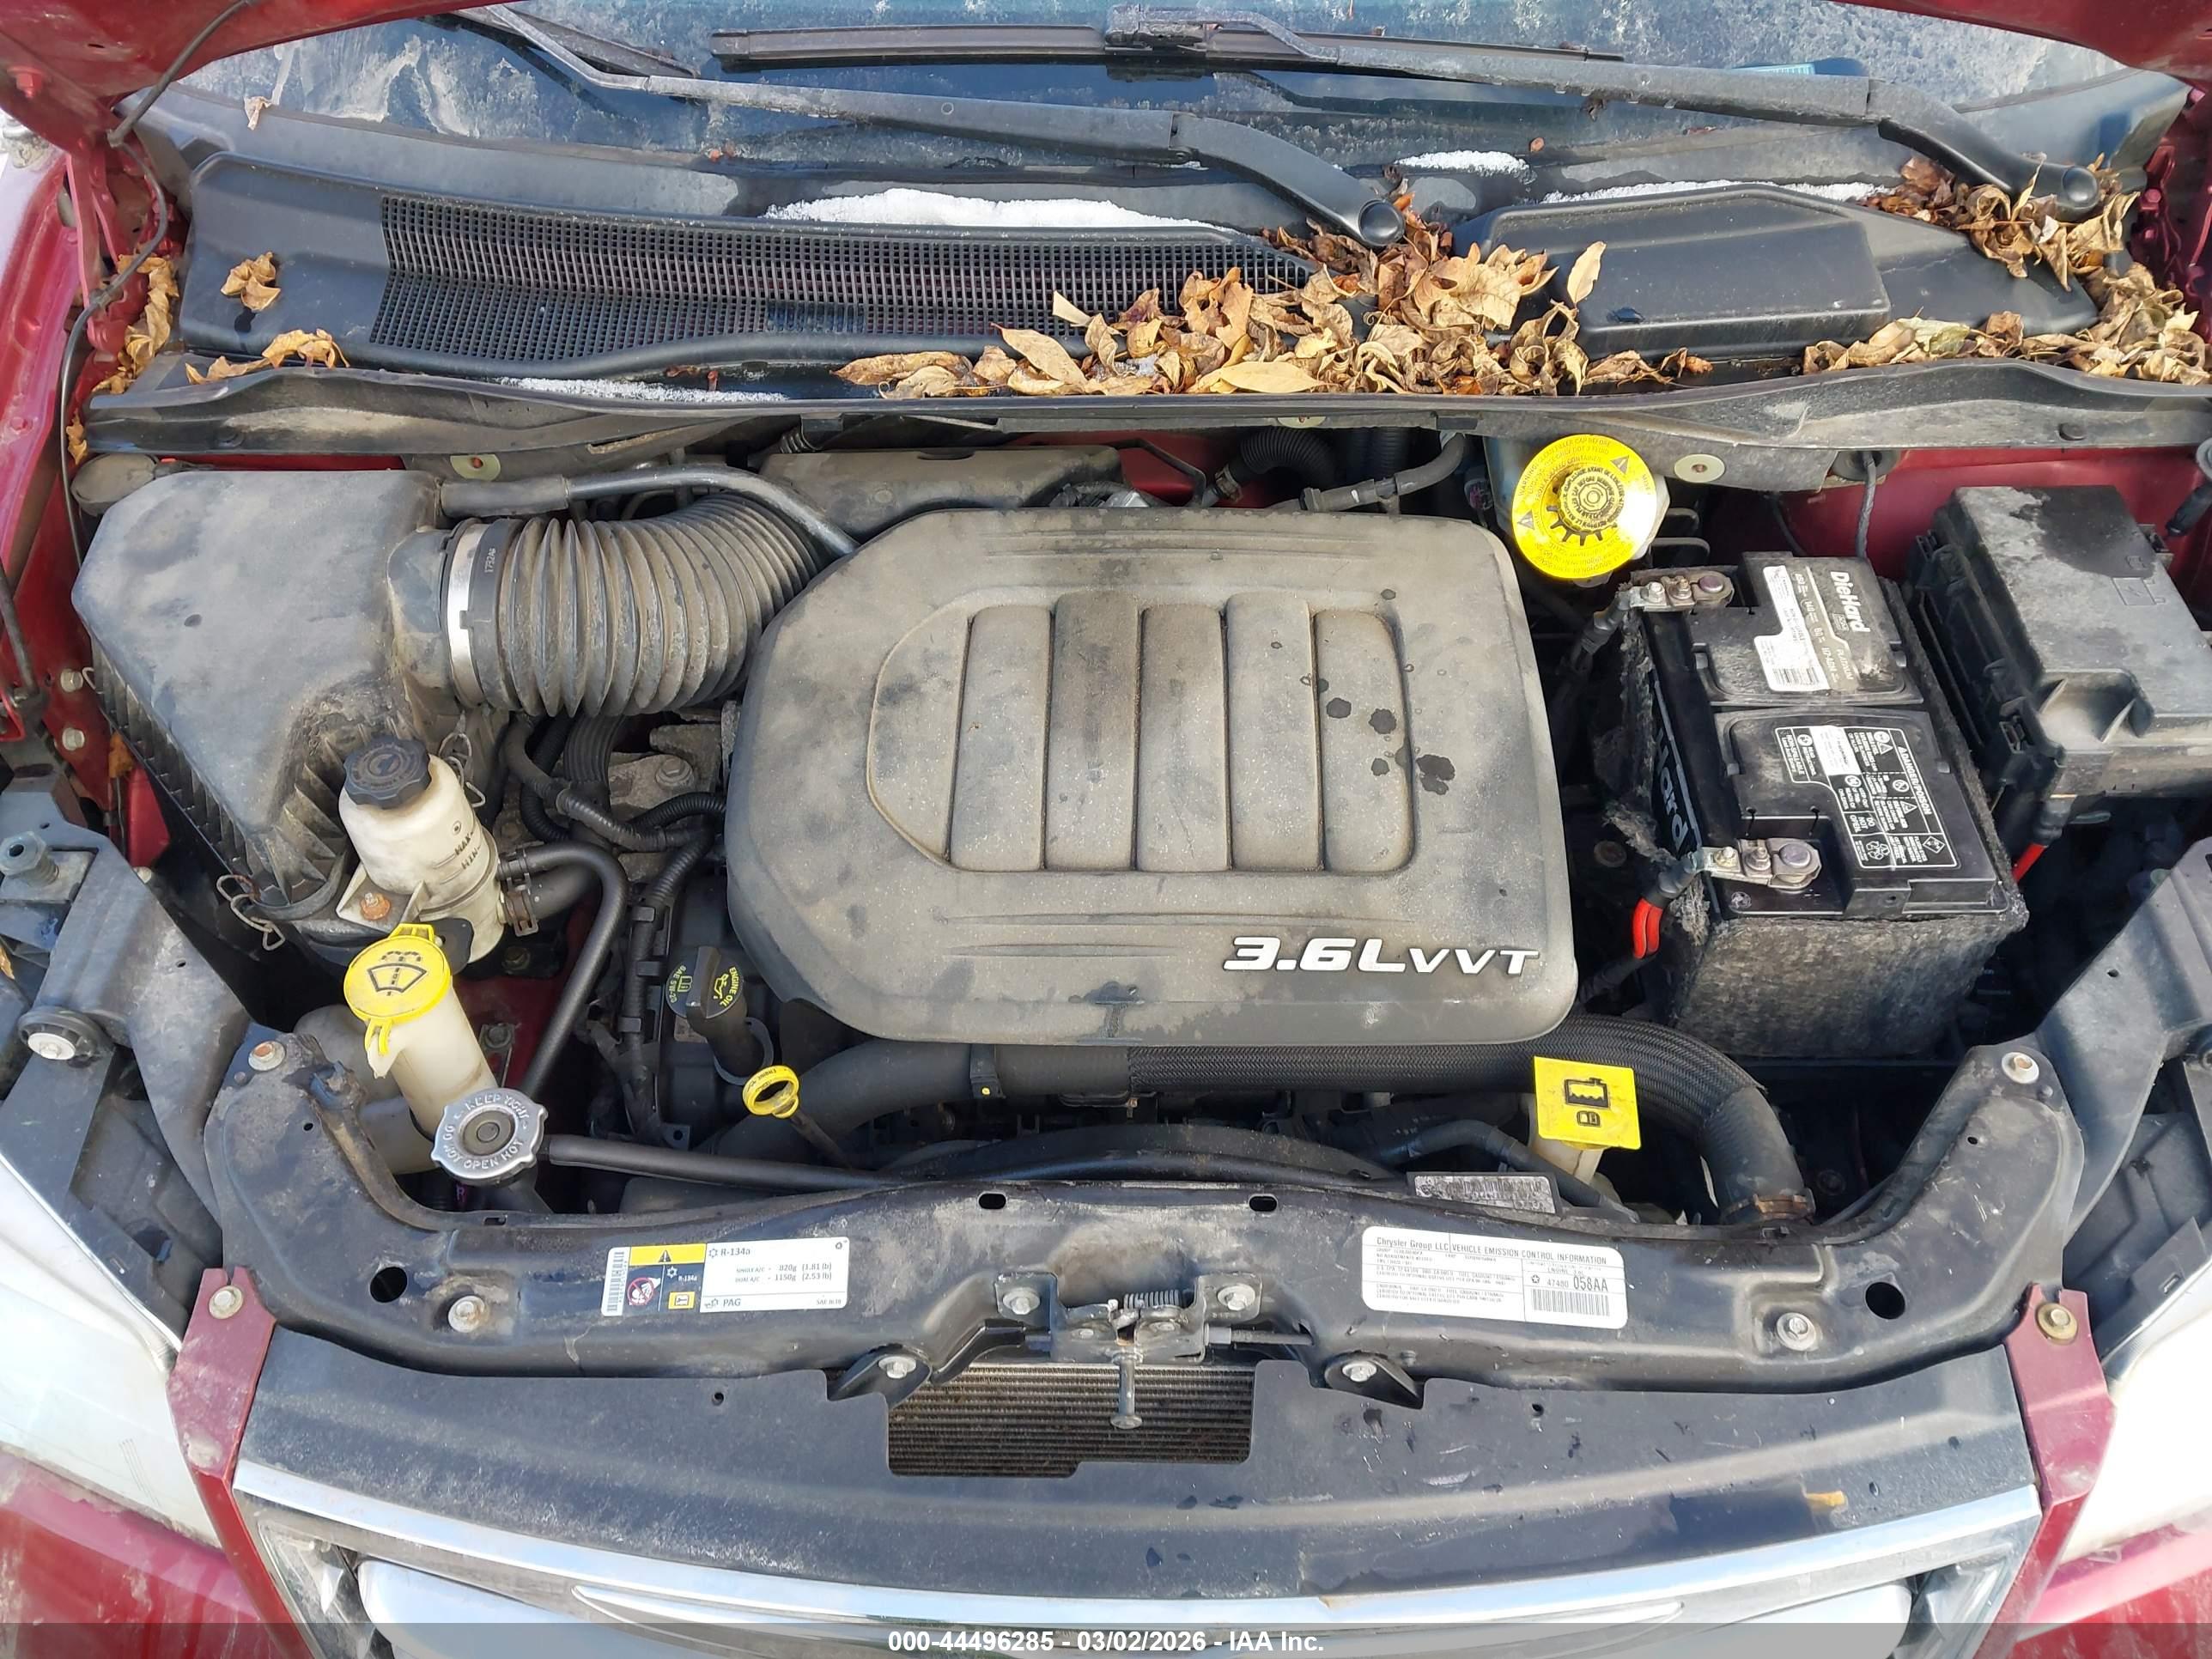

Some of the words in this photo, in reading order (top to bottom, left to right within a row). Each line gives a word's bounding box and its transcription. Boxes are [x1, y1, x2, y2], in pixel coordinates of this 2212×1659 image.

[1830, 571, 1871, 632] DieHard
[1786, 735, 1806, 775] NON-SPILLABLE
[1655, 727, 1689, 851] Hard
[1858, 817, 1868, 830] NOT
[1867, 817, 1875, 827] DO
[1223, 936, 1407, 973] 3.6L
[1408, 947, 1540, 975] VVT
[729, 966, 738, 995] ENGINE
[720, 995, 733, 1007] OIL
[465, 1094, 500, 1110] KEEP
[445, 1146, 463, 1163] NOT
[464, 1159, 498, 1170] OPEN
[501, 1139, 523, 1161] HOT
[1376, 1237, 1407, 1248] Chrysler
[1410, 1239, 1432, 1251] Group
[720, 1247, 751, 1257] R-134a
[1452, 1243, 1481, 1253] VEHICLE
[1485, 1248, 1519, 1257] EMISSION
[1522, 1250, 1553, 1260] CONTROL
[1557, 1253, 1607, 1265] INFORMATION
[821, 1262, 832, 1272] lb)
[775, 1273, 796, 1282] 1150g
[802, 1272, 821, 1281] (2.53
[822, 1272, 832, 1281] lb)
[1573, 1276, 1608, 1291] 058AA
[722, 1297, 741, 1307] PAG
